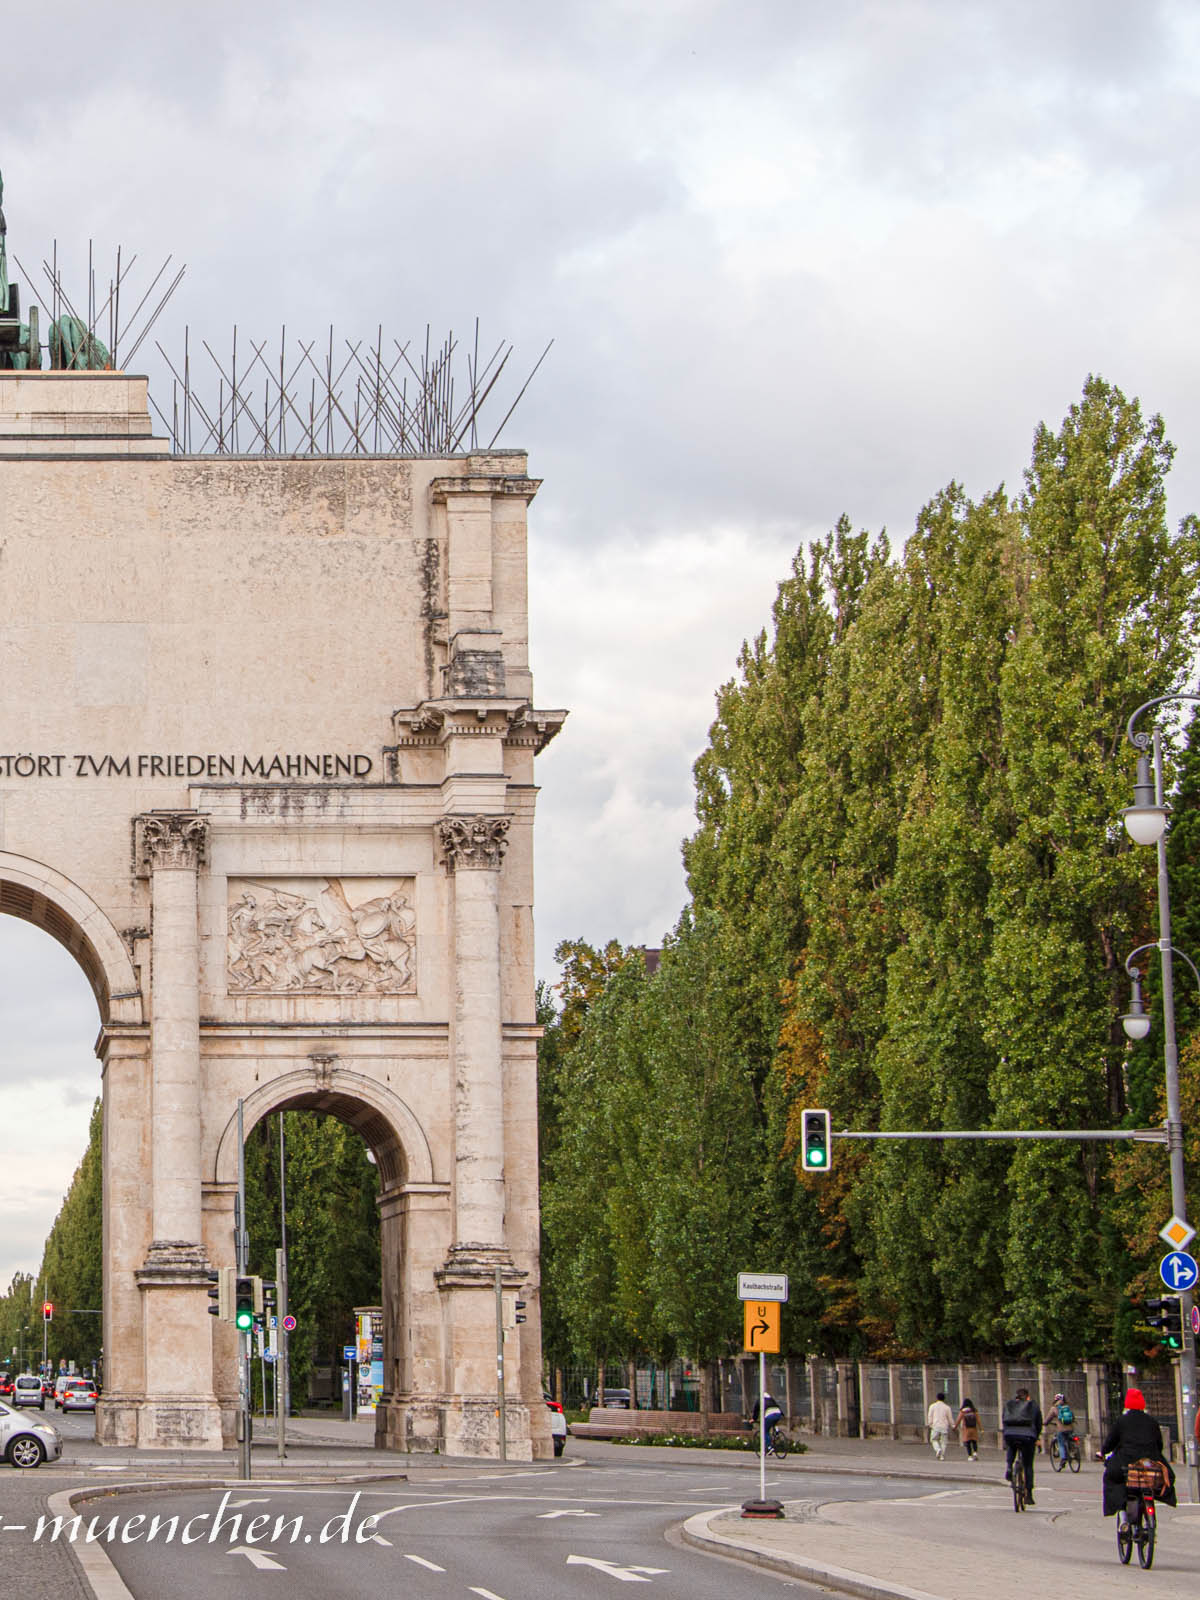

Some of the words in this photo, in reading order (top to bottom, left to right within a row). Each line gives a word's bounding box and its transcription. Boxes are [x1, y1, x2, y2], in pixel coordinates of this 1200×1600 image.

[73, 754, 131, 777] ZVM
[138, 754, 235, 777] FRIEDEN
[241, 754, 374, 778] MAHNEND
[743, 1282, 783, 1291] Kaulbachstraße
[757, 1306, 767, 1318] U
